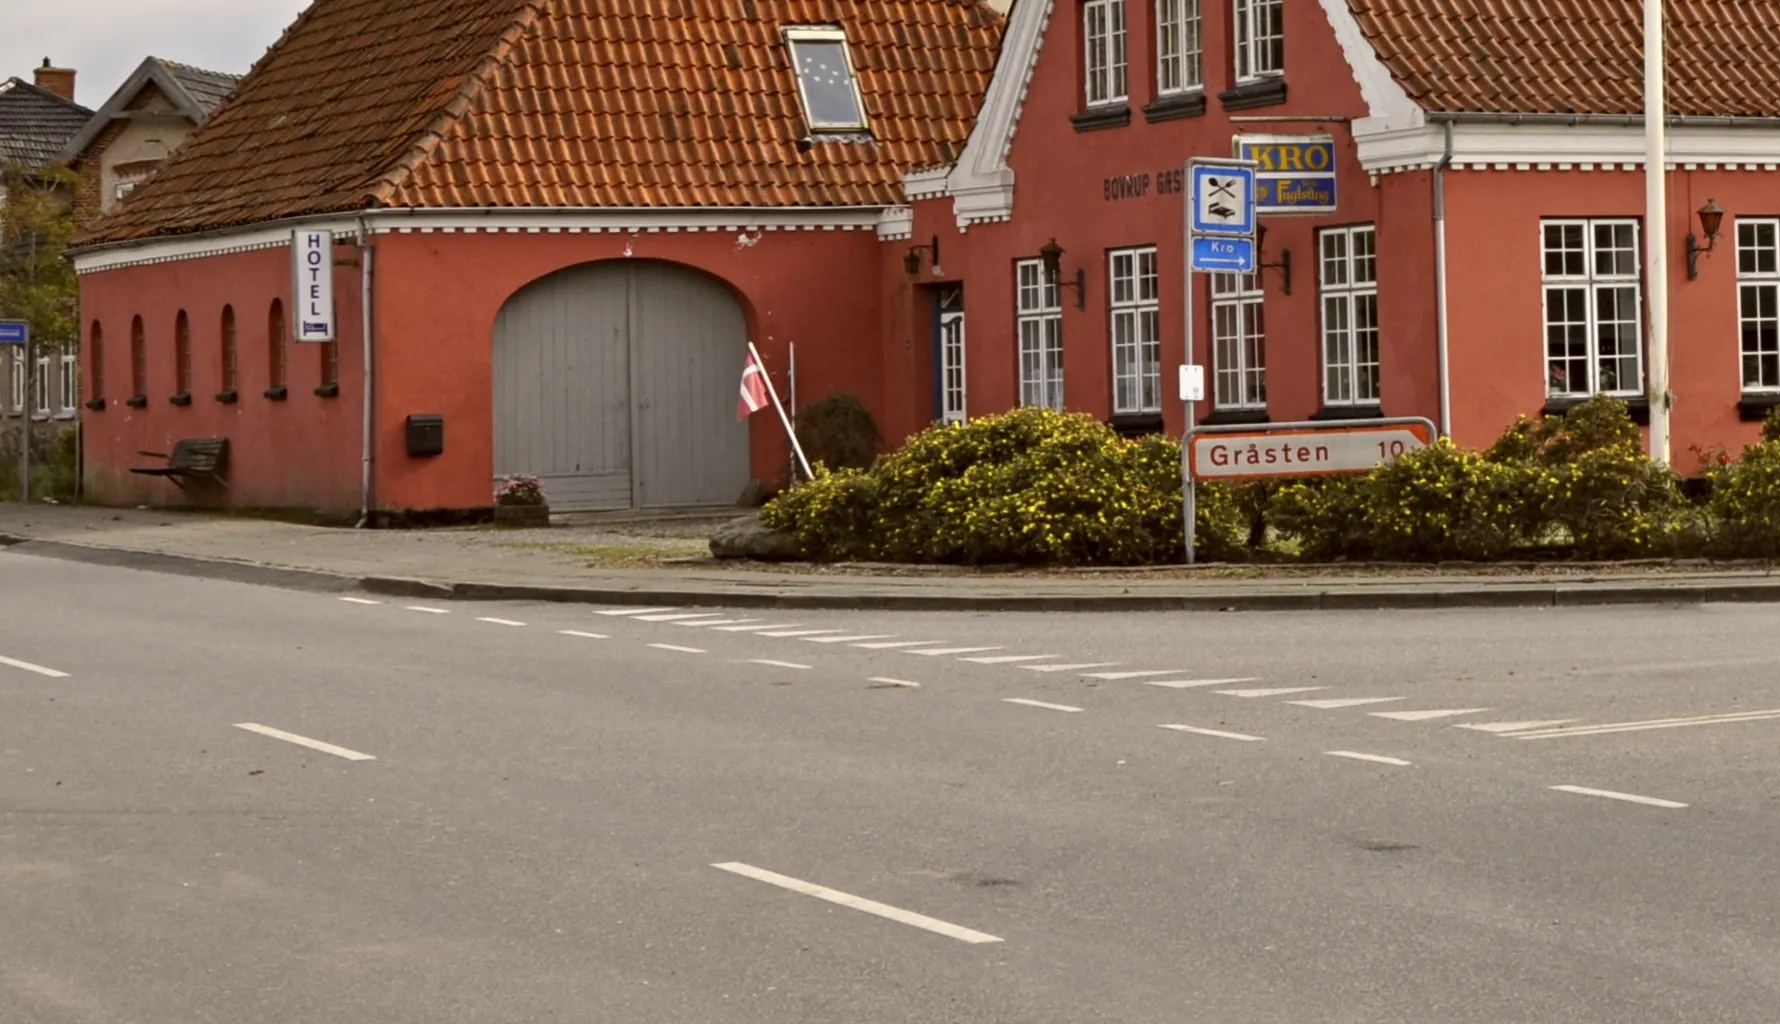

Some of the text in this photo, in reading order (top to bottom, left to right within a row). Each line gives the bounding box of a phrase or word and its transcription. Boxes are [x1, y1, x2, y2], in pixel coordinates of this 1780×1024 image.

[1250, 145, 1329, 170] KRO
[1103, 173, 1149, 202] BOVRUP
[1211, 241, 1235, 253] Kro
[307, 234, 322, 316] HOTEL
[1210, 440, 1405, 466] Gråsten 10
